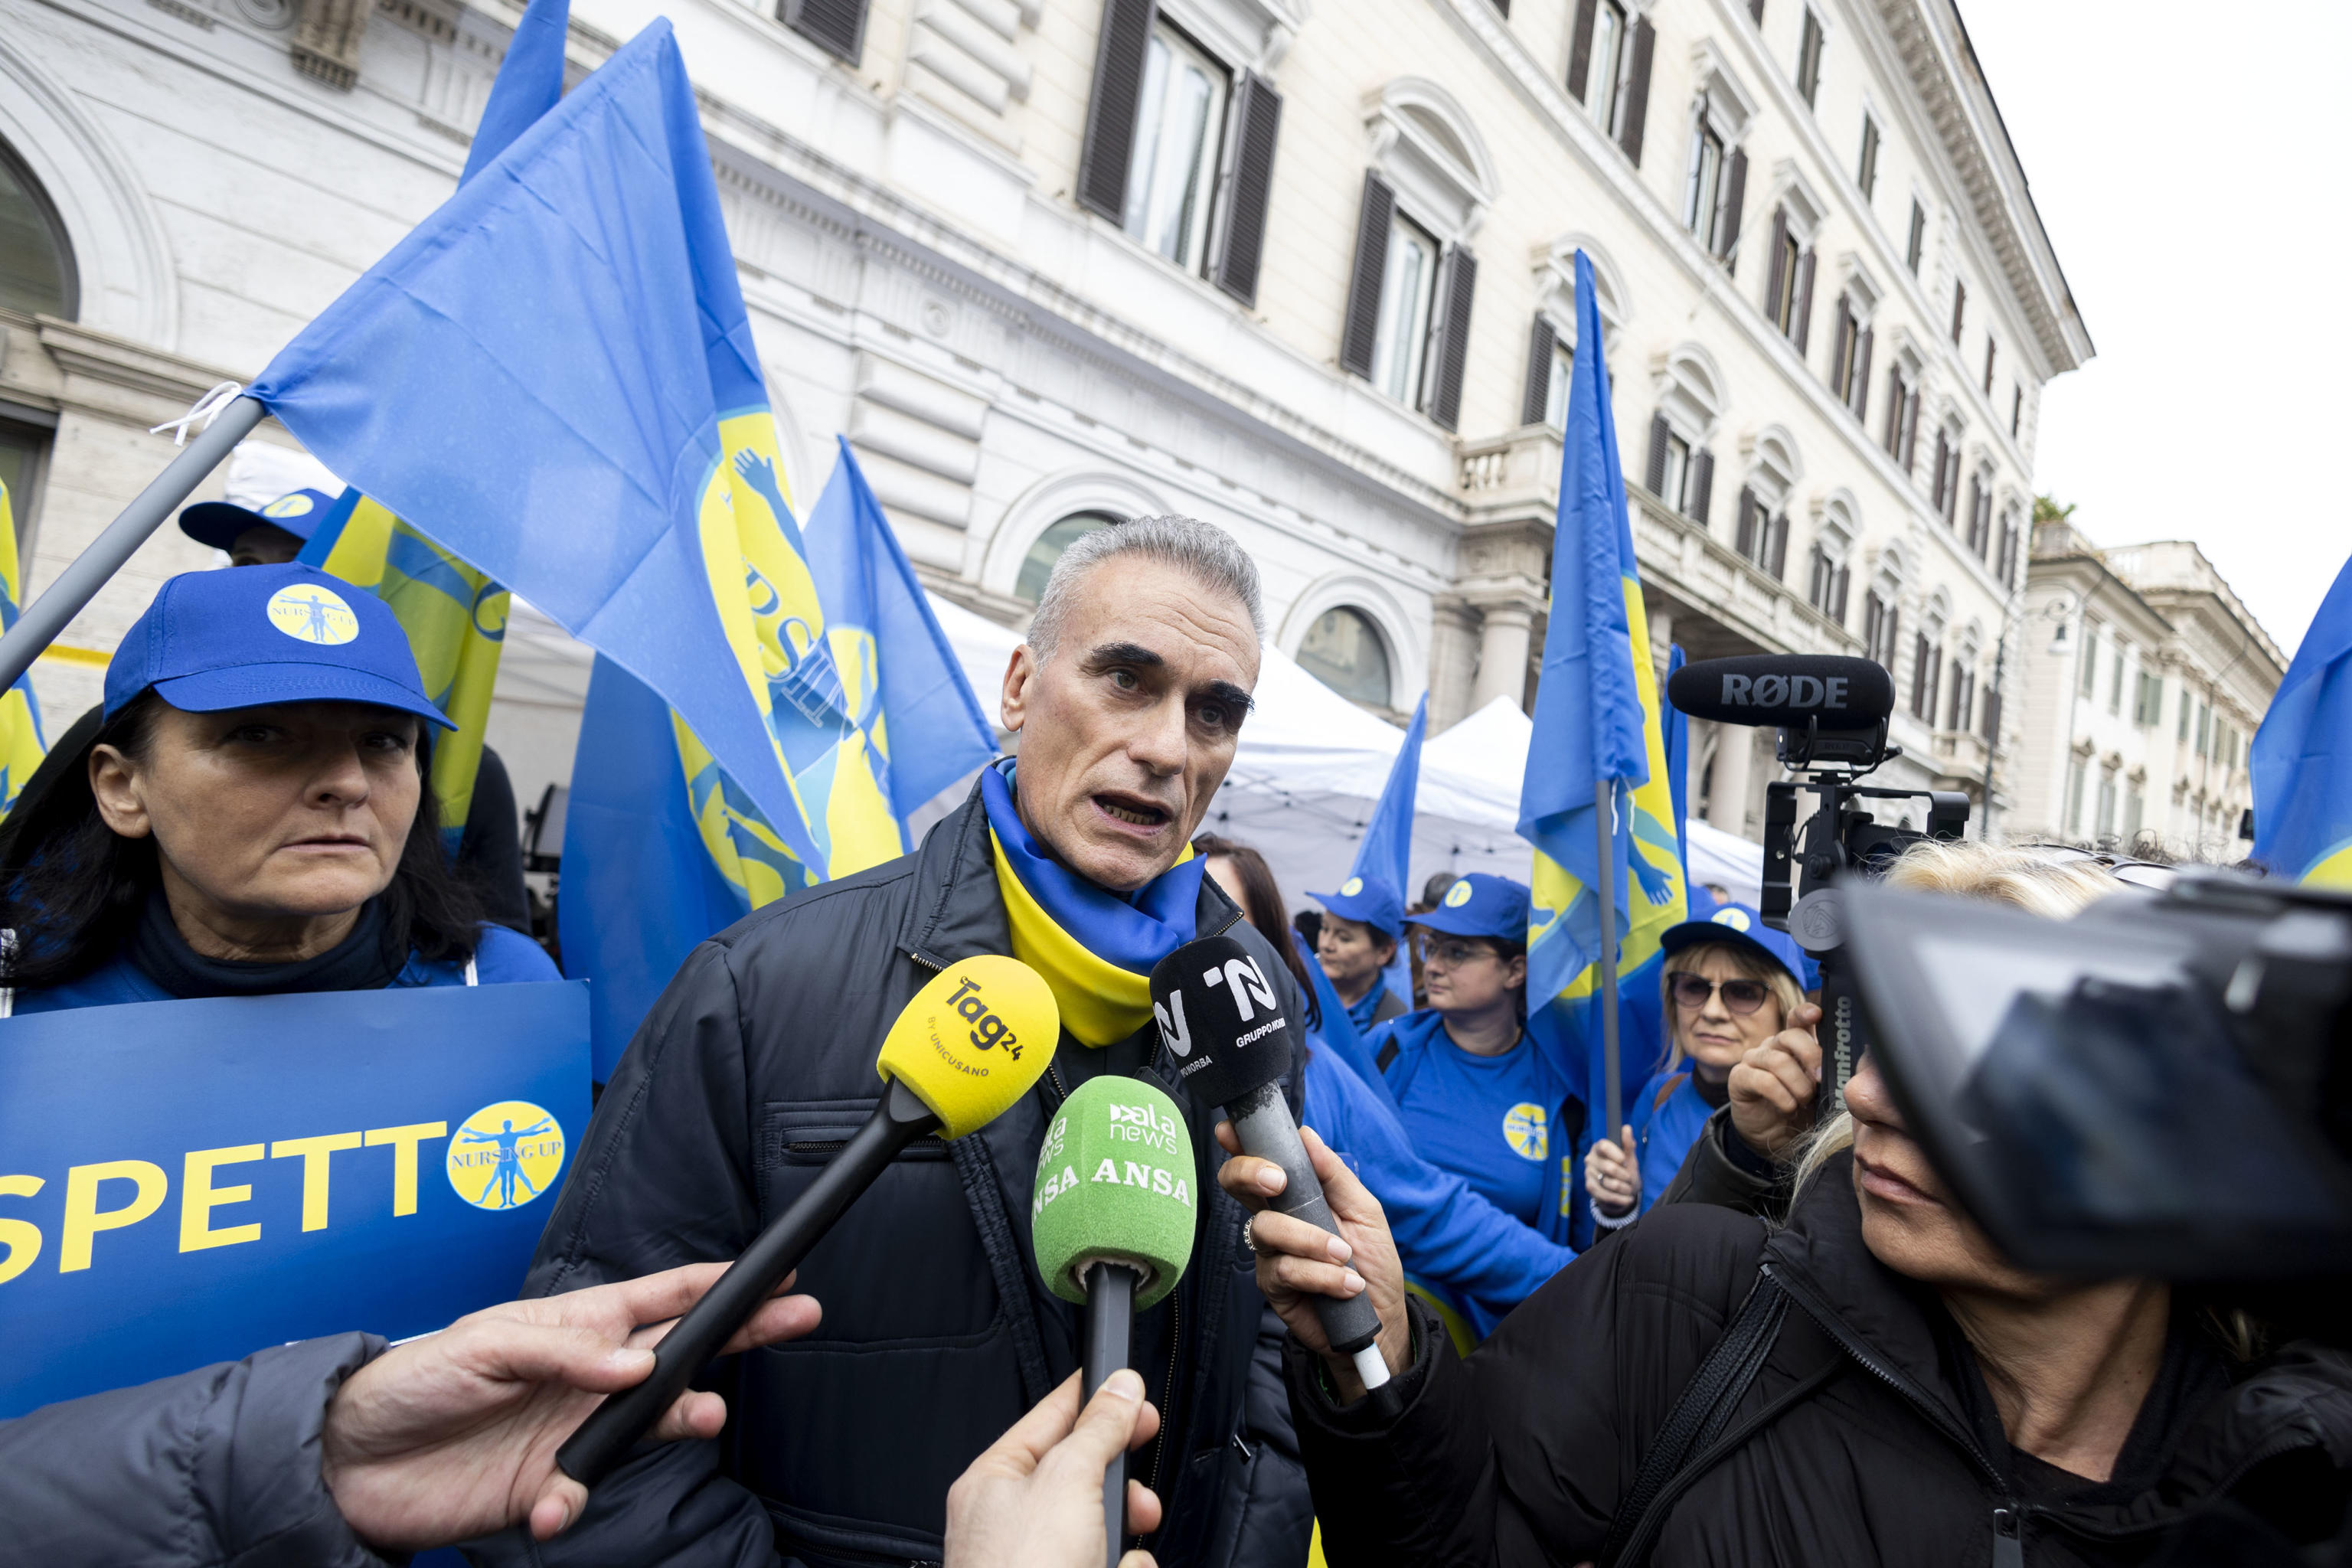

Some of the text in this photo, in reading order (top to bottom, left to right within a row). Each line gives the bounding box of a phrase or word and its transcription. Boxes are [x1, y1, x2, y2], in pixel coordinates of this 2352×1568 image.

[1721, 674, 1848, 709] RØDE
[927, 1016, 990, 1077] BY UNICUSANO
[1236, 1023, 1272, 1048] GRUPPO
[450, 1141, 562, 1171] NURSING UP
[1109, 1122, 1178, 1155] news
[1032, 1165, 1080, 1226] NSA
[1091, 1158, 1192, 1208] ANSA
